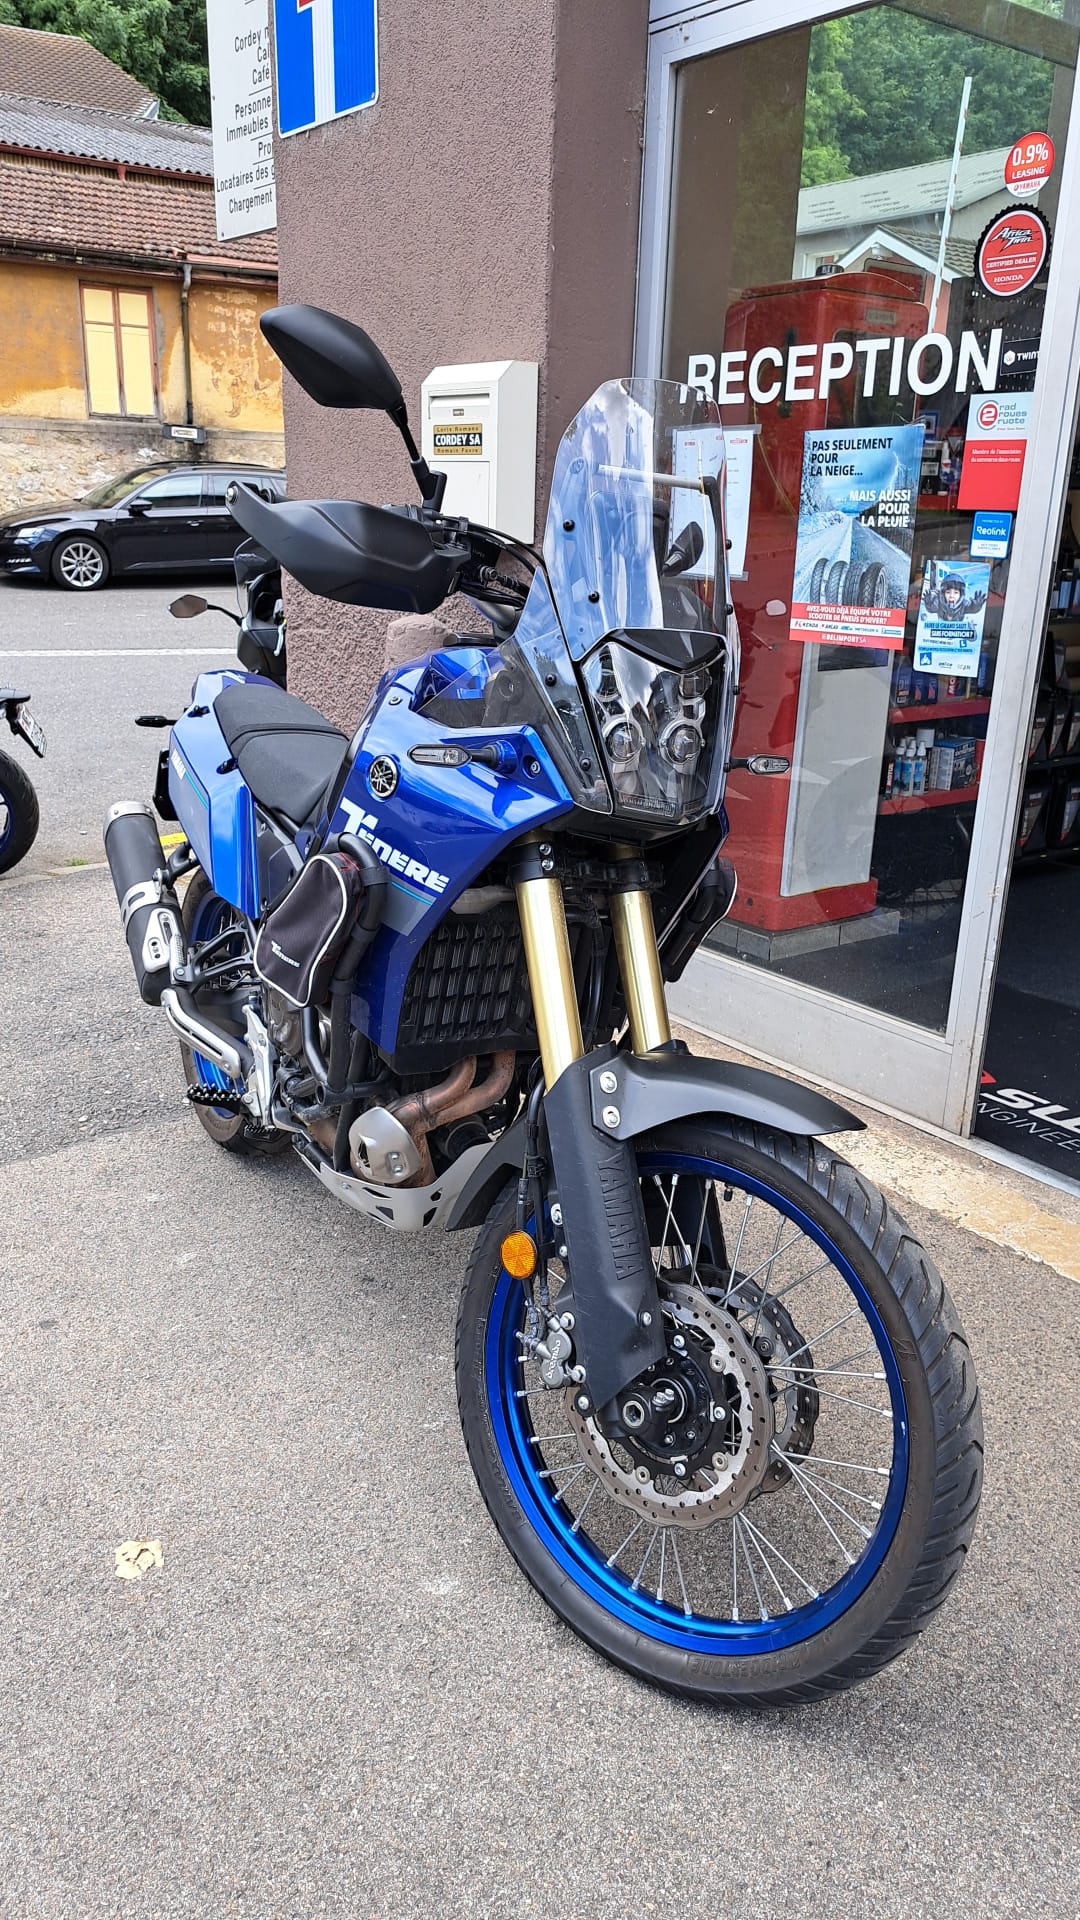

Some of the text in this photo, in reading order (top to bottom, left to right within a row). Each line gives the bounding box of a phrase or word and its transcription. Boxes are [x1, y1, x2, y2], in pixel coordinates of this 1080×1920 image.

[234, 28, 261, 52] Cordey
[252, 62, 270, 84] Café
[234, 95, 271, 120] Personne
[226, 115, 269, 142] Immeubles
[258, 141, 272, 157] Pro
[1011, 141, 1049, 167] 0.9%
[216, 170, 254, 192] Locataires
[255, 164, 269, 181] des
[228, 187, 273, 213] Chargement
[1014, 256, 1037, 265] DEALER
[993, 273, 1024, 283] HONDA
[680, 329, 1003, 405] RECEPTION
[435, 433, 481, 446] CORDEY SA
[812, 437, 893, 452] PAS SEULEMENT
[811, 452, 839, 464] POUR
[810, 464, 863, 477] LA NEIGE...
[879, 489, 911, 501] AUSSI
[878, 502, 910, 515] POUR
[861, 515, 909, 528] LA PLUIE
[976, 526, 1007, 537] Reolink
[806, 604, 836, 614] AVEZ-VOUS
[871, 609, 892, 618] VOTRE
[808, 612, 833, 621] SCOOTER
[841, 614, 859, 623] PNEUS
[598, 1151, 645, 1281] YAMAHA
[545, 1339, 561, 1379] brembo
